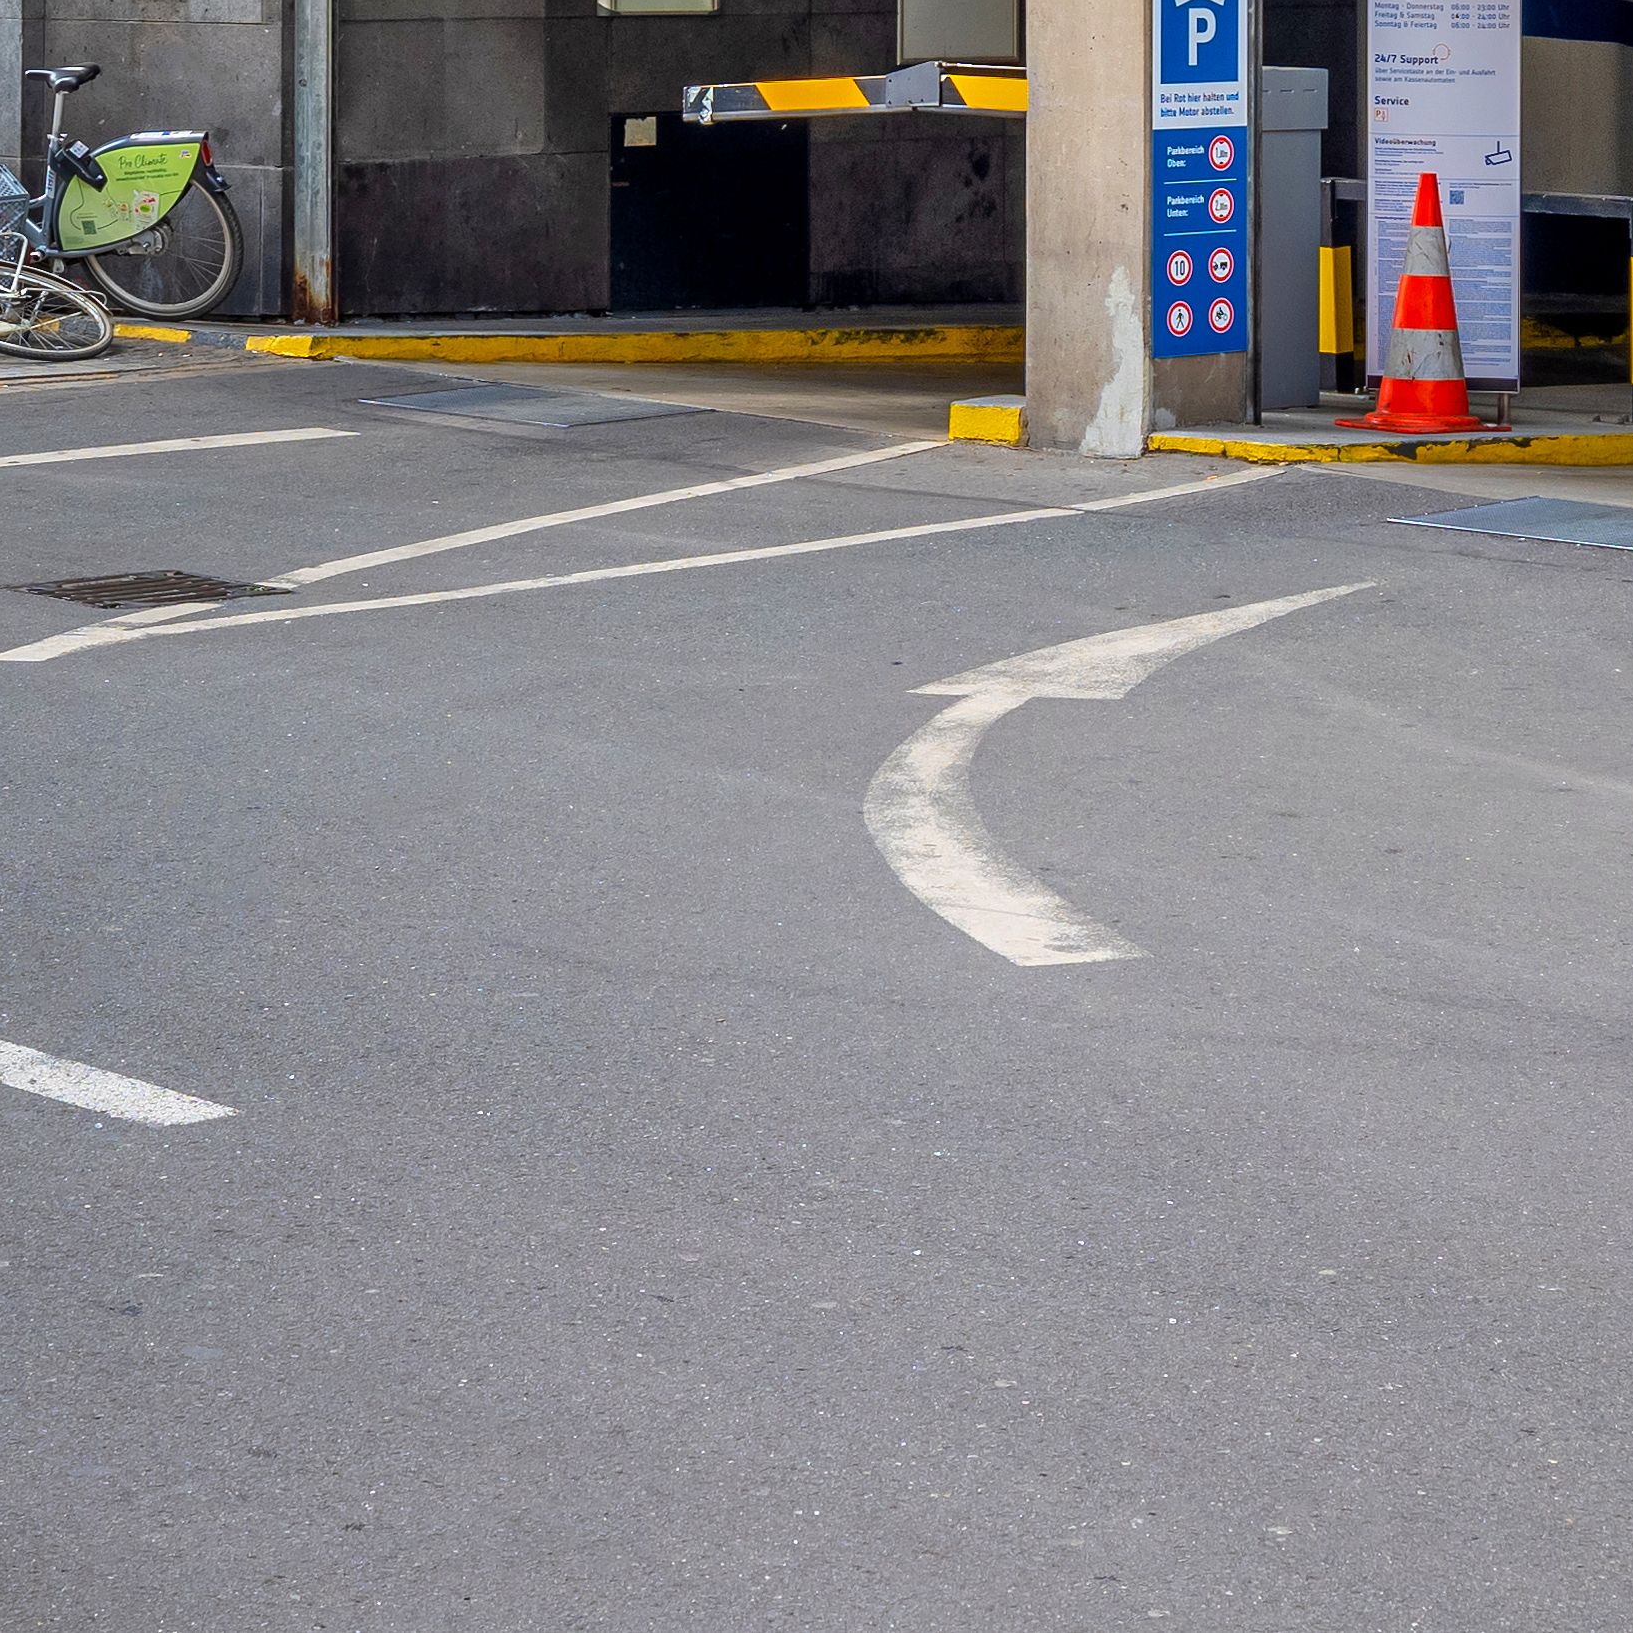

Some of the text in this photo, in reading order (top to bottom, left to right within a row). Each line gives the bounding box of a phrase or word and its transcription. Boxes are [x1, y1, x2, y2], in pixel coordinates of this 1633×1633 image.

[1375, 1, 1399, 10] Montag
[1406, 2, 1444, 11] Donnerstag
[1375, 11, 1397, 19] Freitag
[1406, 12, 1435, 20] Samstag
[1375, 20, 1401, 28] Sonntag
[1410, 21, 1437, 29] Feiertag
[1188, 7, 1217, 66] P
[1375, 54, 1438, 66] 24/7 Support
[1160, 91, 1239, 103] Bei Rot hier halten und
[1374, 95, 1410, 106] Service
[1160, 108, 1177, 117] bitte
[1179, 107, 1199, 117] Motor
[1375, 137, 1436, 146] Videoüberwachung
[1167, 145, 1204, 156] Parkbereich
[1167, 194, 1204, 205] Parkbereich
[1175, 260, 1186, 276] 10
